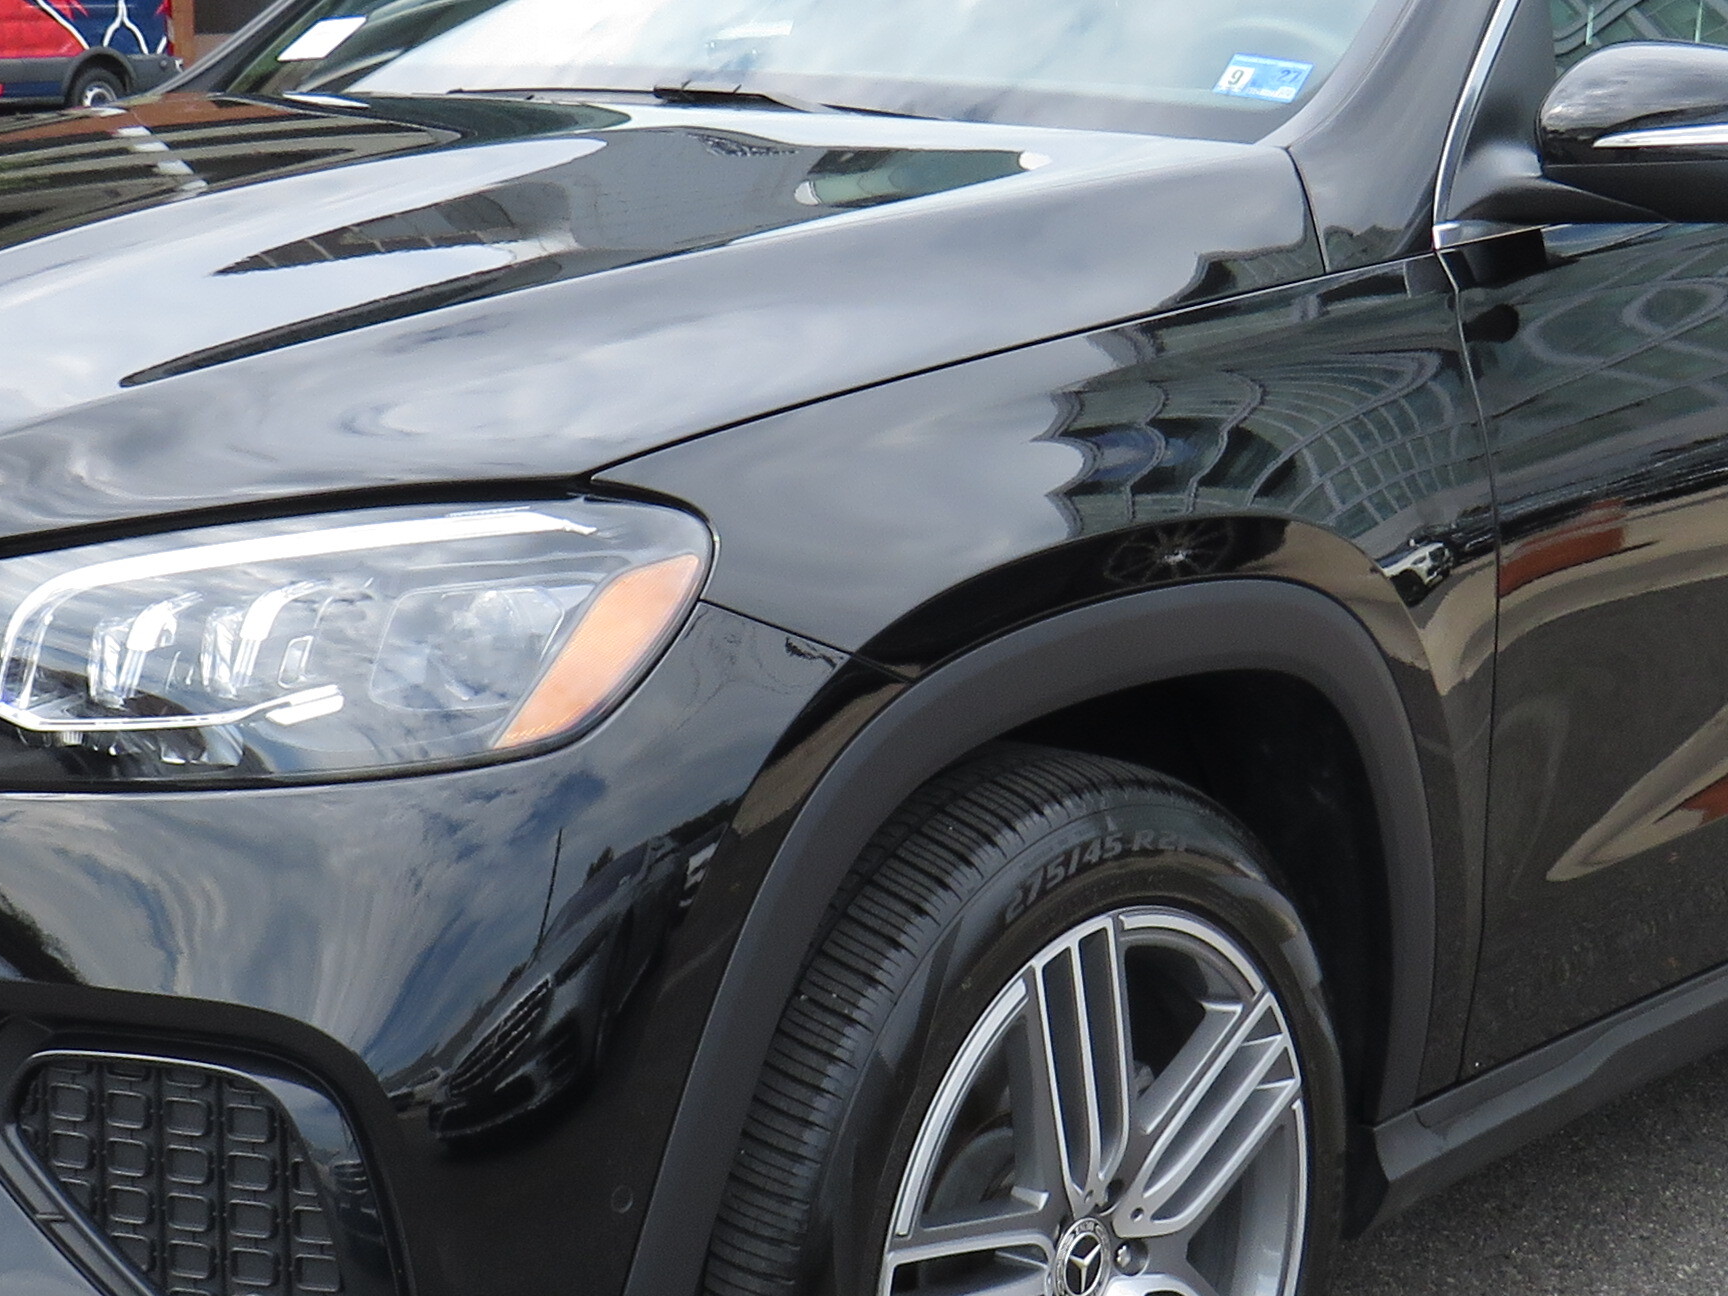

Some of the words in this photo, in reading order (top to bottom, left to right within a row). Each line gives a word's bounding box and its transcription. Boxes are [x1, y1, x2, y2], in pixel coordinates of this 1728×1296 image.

[1227, 68, 1245, 86] 9
[1276, 68, 1303, 85] 27
[1005, 831, 1122, 926] 275/45
